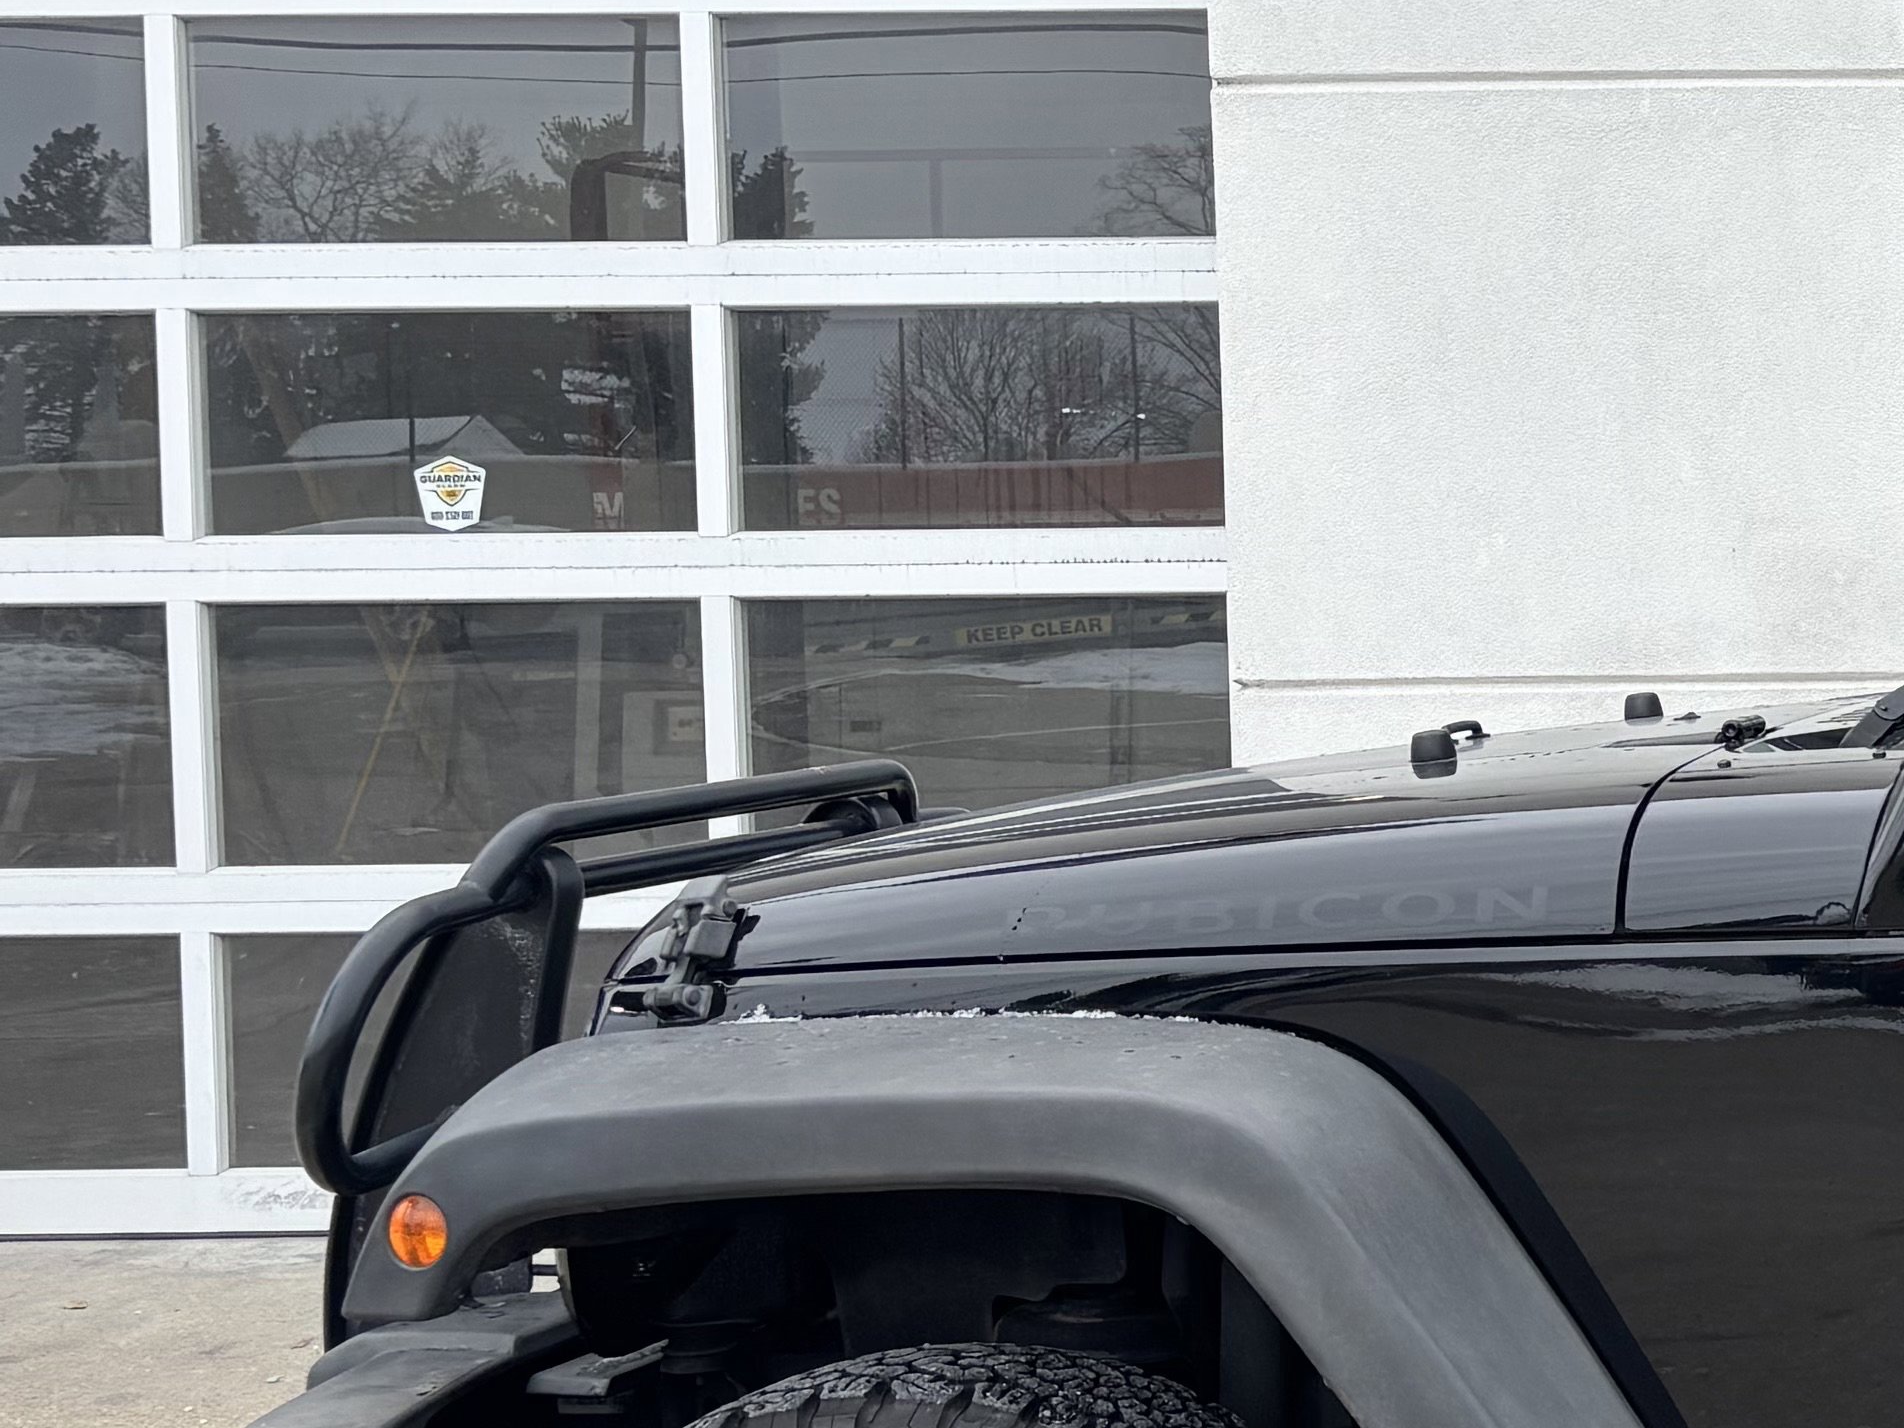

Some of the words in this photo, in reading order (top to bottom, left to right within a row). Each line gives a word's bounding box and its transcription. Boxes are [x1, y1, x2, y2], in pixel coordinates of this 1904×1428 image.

[420, 474, 481, 484] GUARDIAN
[966, 626, 1024, 644] KEEP
[1031, 618, 1104, 638] CLEAR
[1008, 886, 1548, 935] RUBICON
